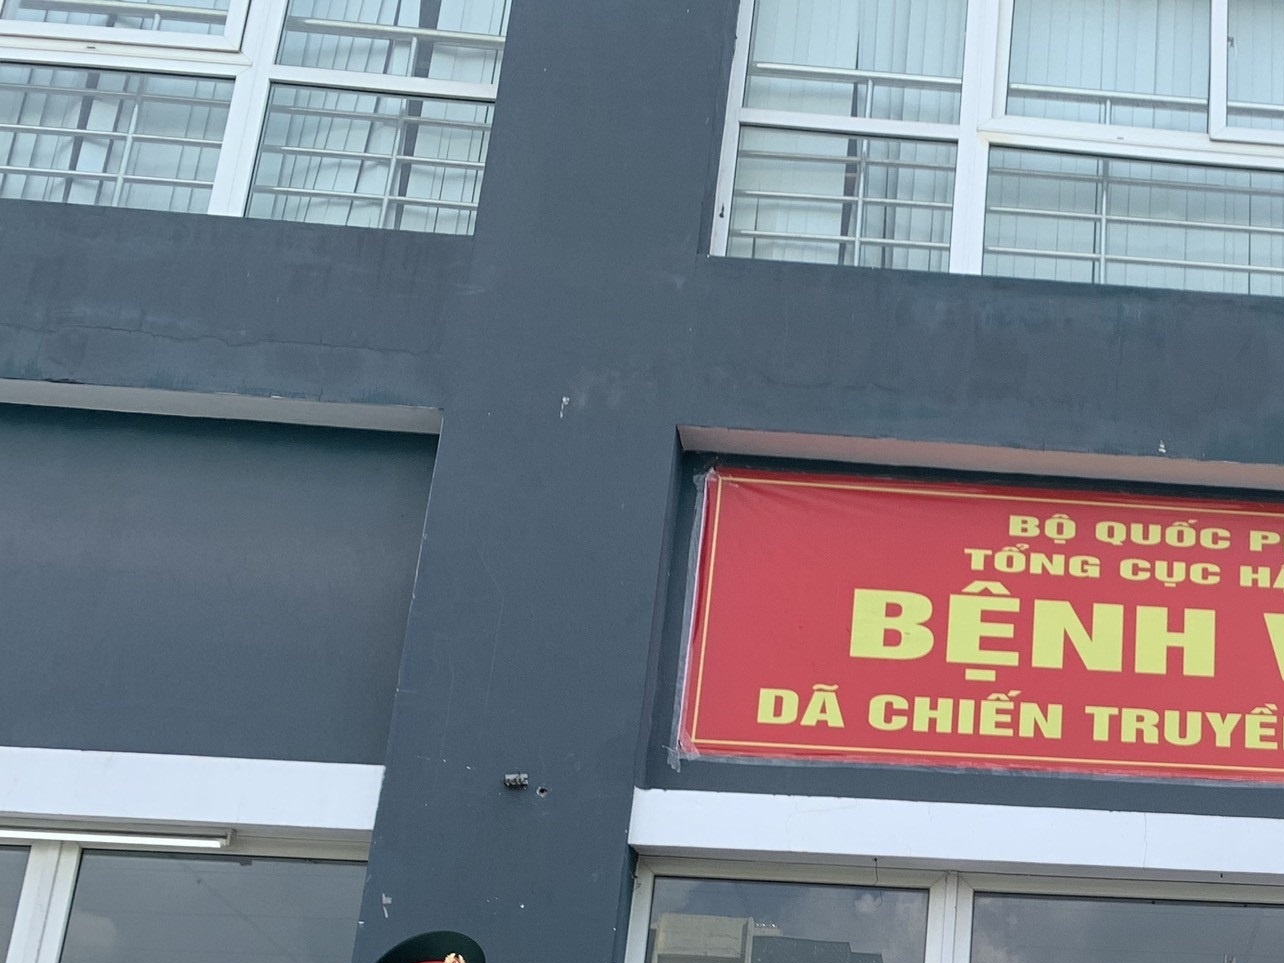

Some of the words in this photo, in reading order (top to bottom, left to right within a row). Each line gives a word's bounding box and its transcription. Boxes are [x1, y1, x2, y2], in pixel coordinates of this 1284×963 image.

[1009, 514, 1077, 544] BỘ
[1095, 519, 1230, 550] QUỐC
[964, 543, 1101, 578] TỔNG
[1119, 558, 1221, 587] CỤC
[849, 580, 1216, 682] BỆNH
[756, 683, 845, 728] DÃ
[868, 690, 1063, 739] CHIẾN
